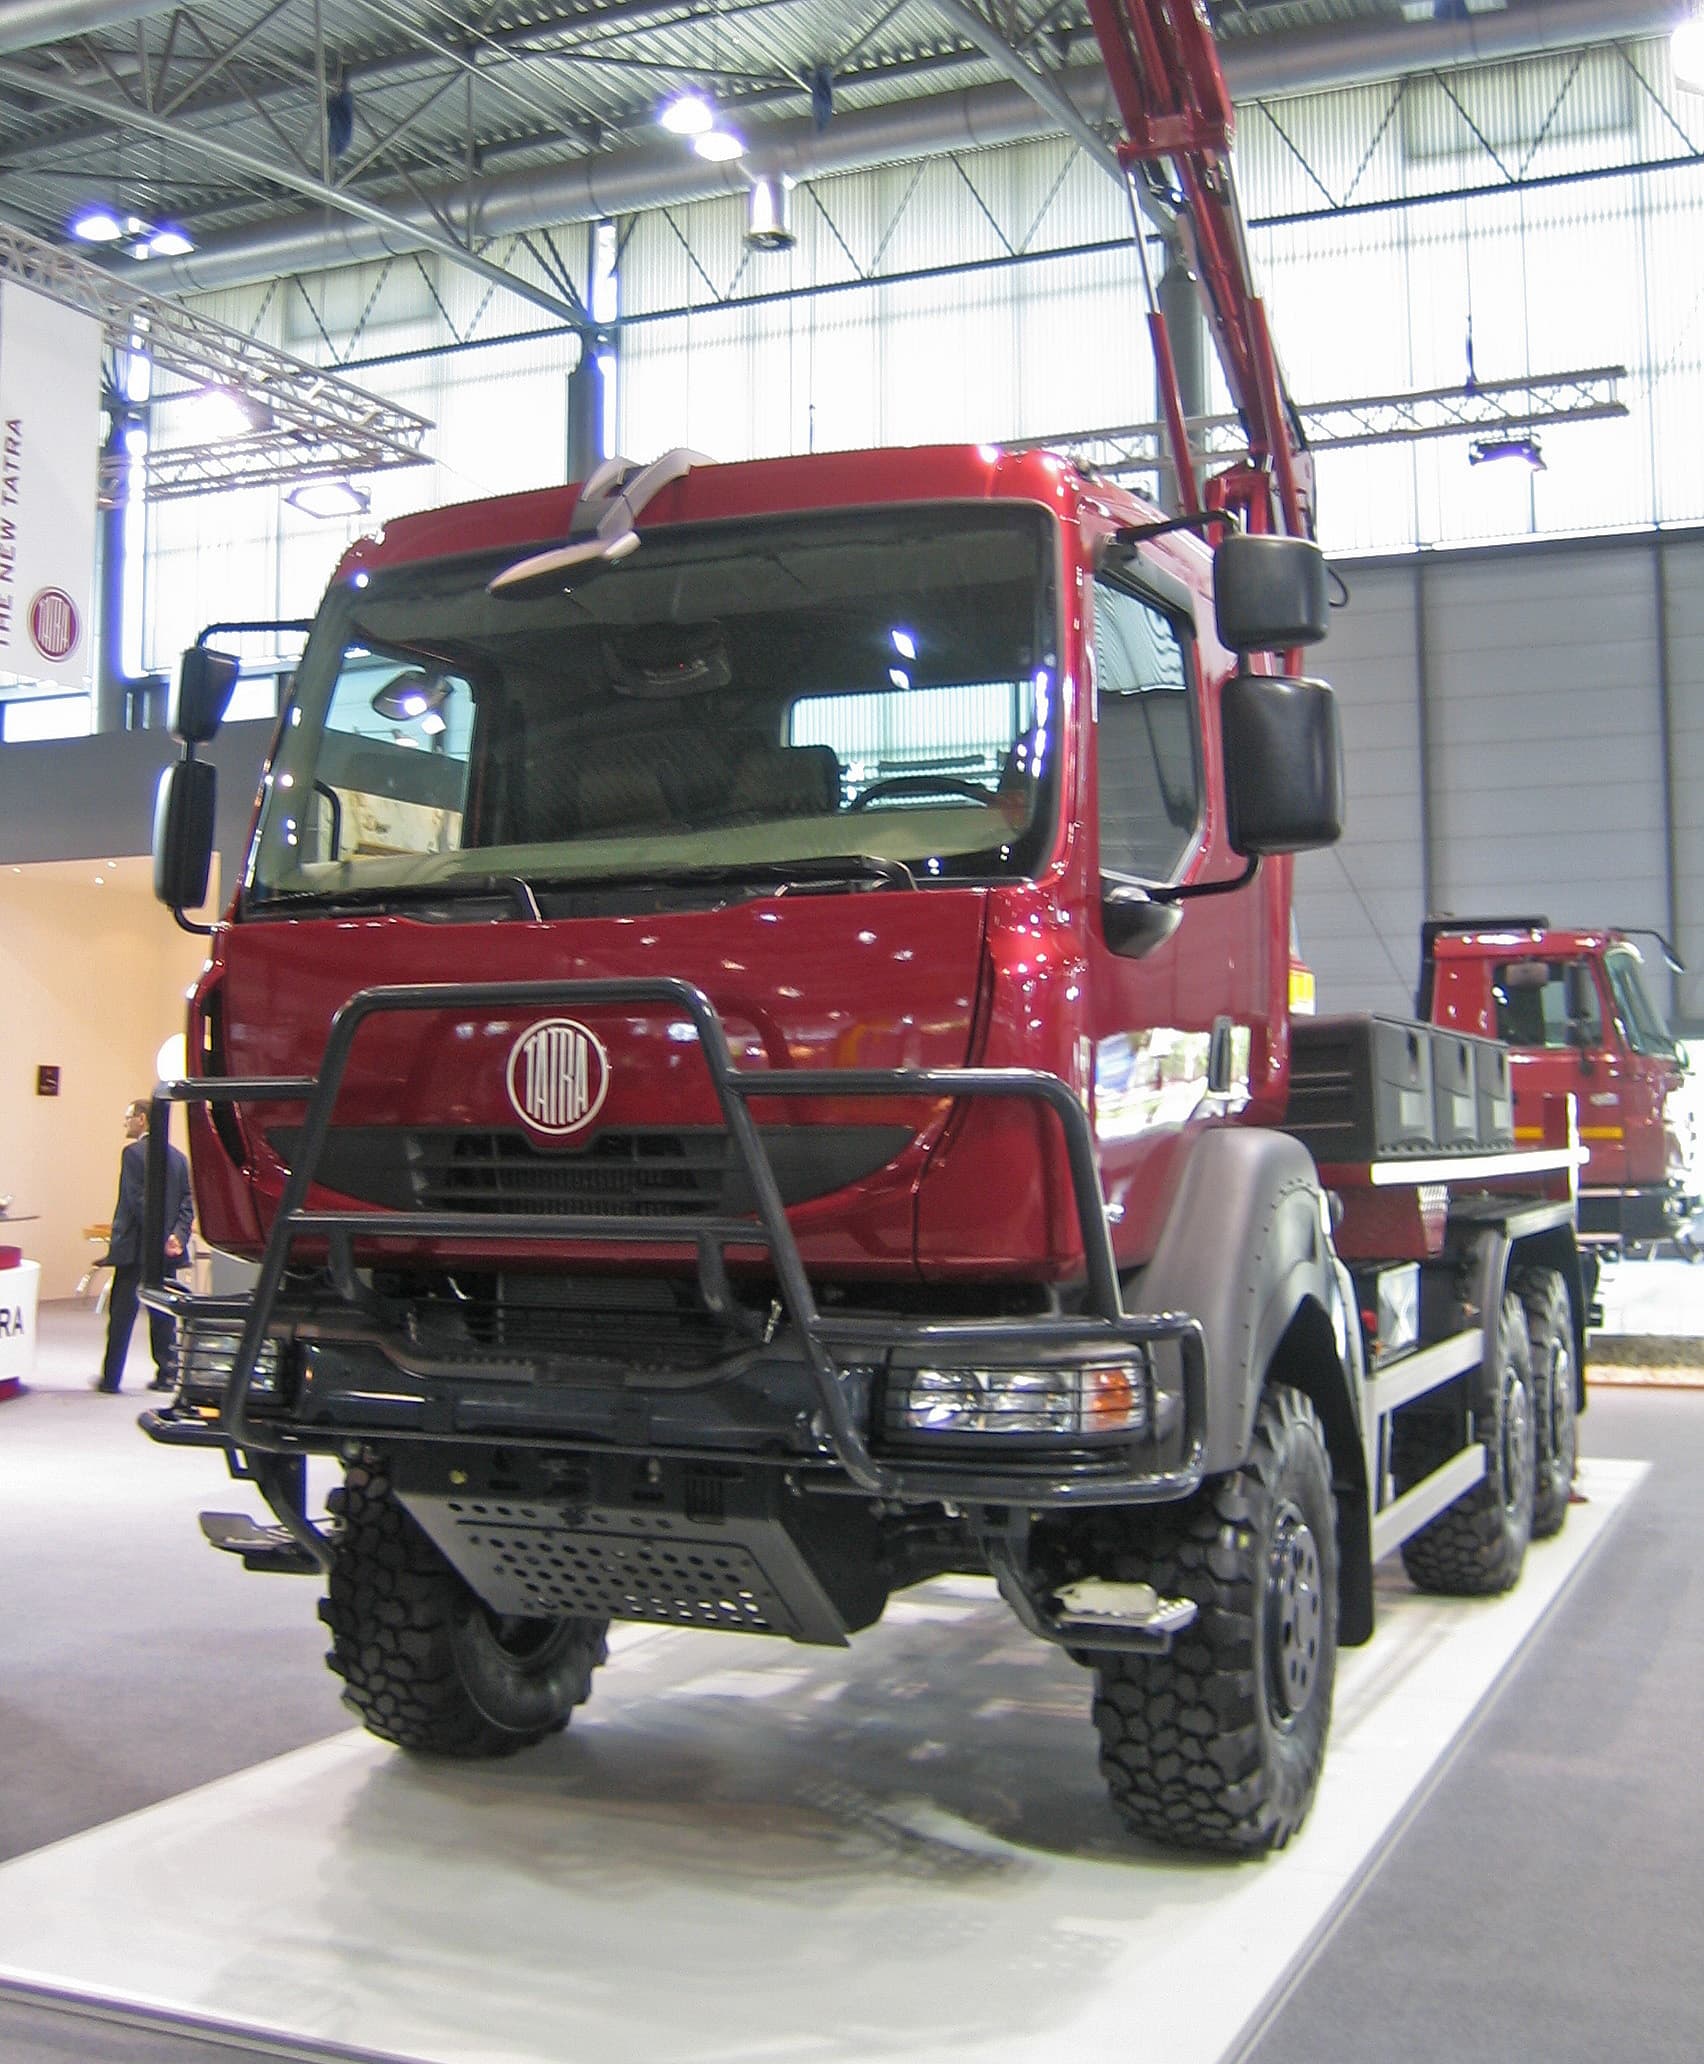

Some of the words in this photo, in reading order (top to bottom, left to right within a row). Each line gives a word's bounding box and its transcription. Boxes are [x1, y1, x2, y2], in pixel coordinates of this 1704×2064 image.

[2, 419, 22, 506] TATRA
[0, 517, 16, 582] NEW
[522, 1026, 589, 1126] TATRA
